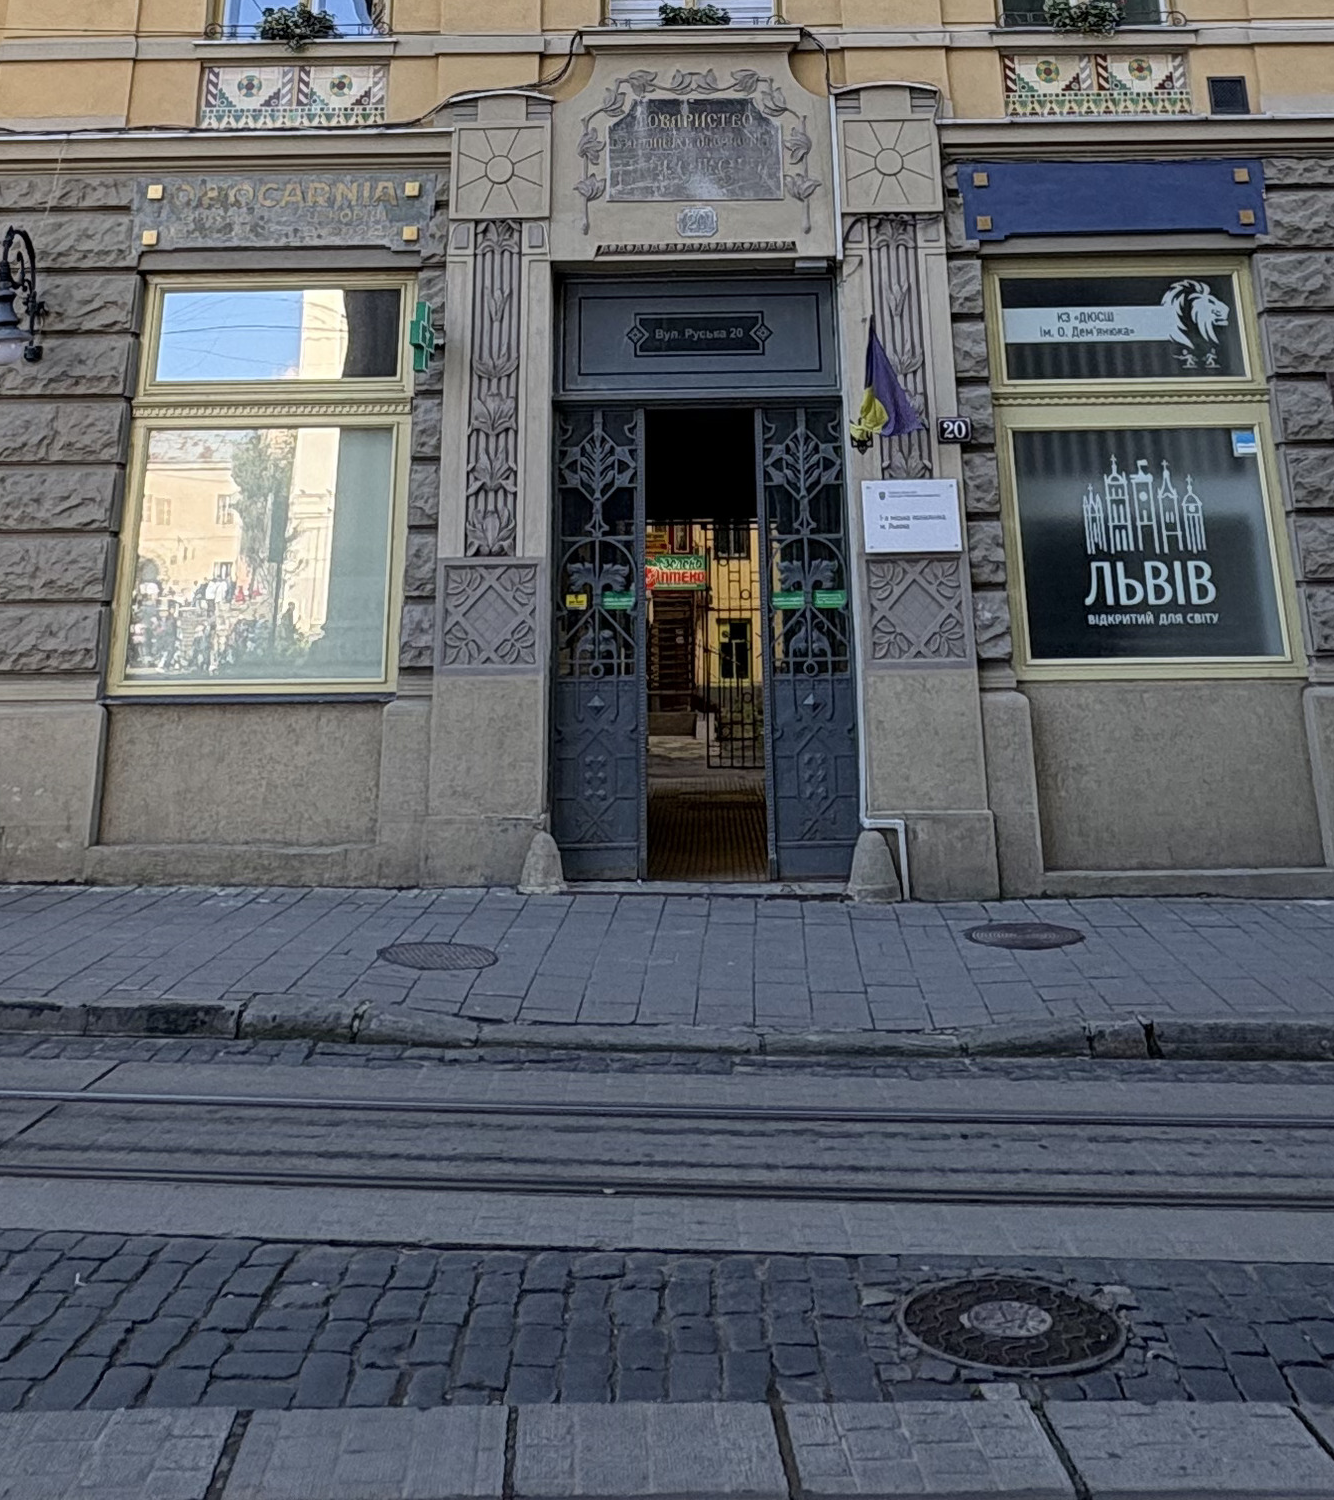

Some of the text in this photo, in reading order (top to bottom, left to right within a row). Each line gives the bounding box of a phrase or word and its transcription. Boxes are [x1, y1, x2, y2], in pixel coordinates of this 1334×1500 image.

[1057, 312, 1071, 323] КЗ
[655, 328, 743, 341] Вул. Руська 20
[943, 420, 966, 439] 20
[1085, 560, 1217, 606] ЛЬВІВ
[1087, 611, 1219, 627] ВІДКРИТИЙ ДЛЯ СВІТУ
